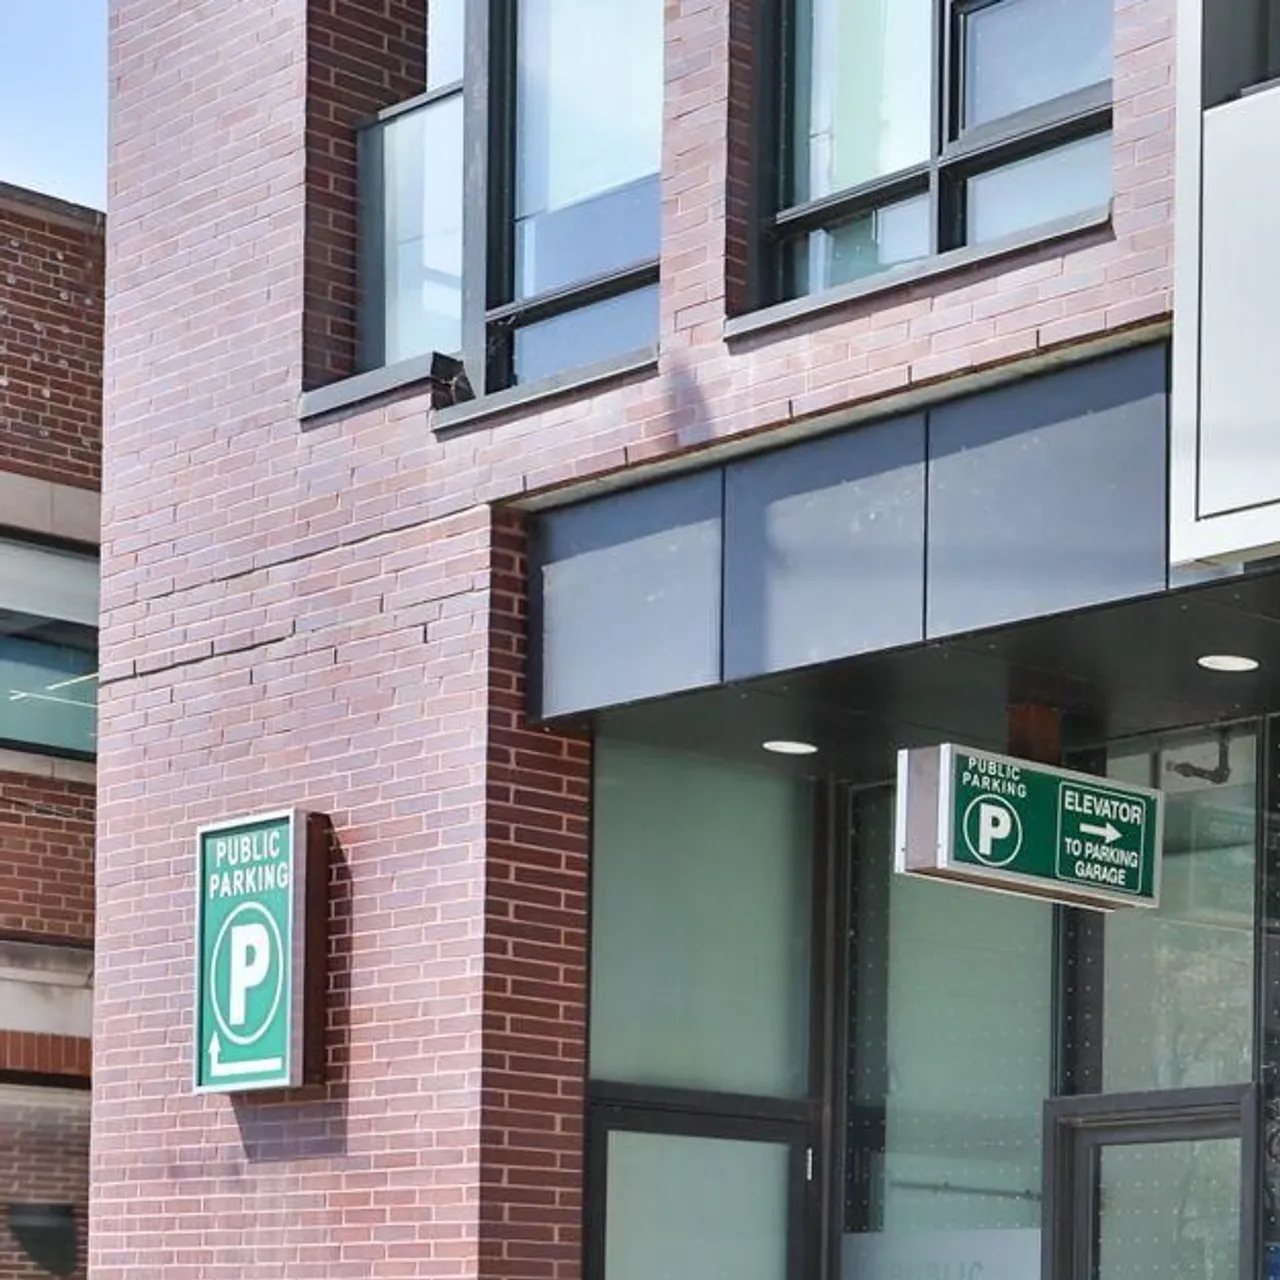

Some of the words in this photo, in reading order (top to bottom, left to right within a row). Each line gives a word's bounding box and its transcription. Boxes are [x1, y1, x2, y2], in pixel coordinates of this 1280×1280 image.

[963, 772, 1027, 798] PARKING
[969, 757, 1020, 781] PUBLIC
[1065, 790, 1142, 825] ELEVATOR
[979, 803, 1012, 855] P
[216, 829, 280, 867] PUBLIC
[1065, 838, 1082, 856] TO
[1085, 842, 1138, 868] PARKING
[209, 863, 289, 899] PARKING
[1075, 860, 1127, 885] GARAGE
[229, 924, 270, 1025] P
